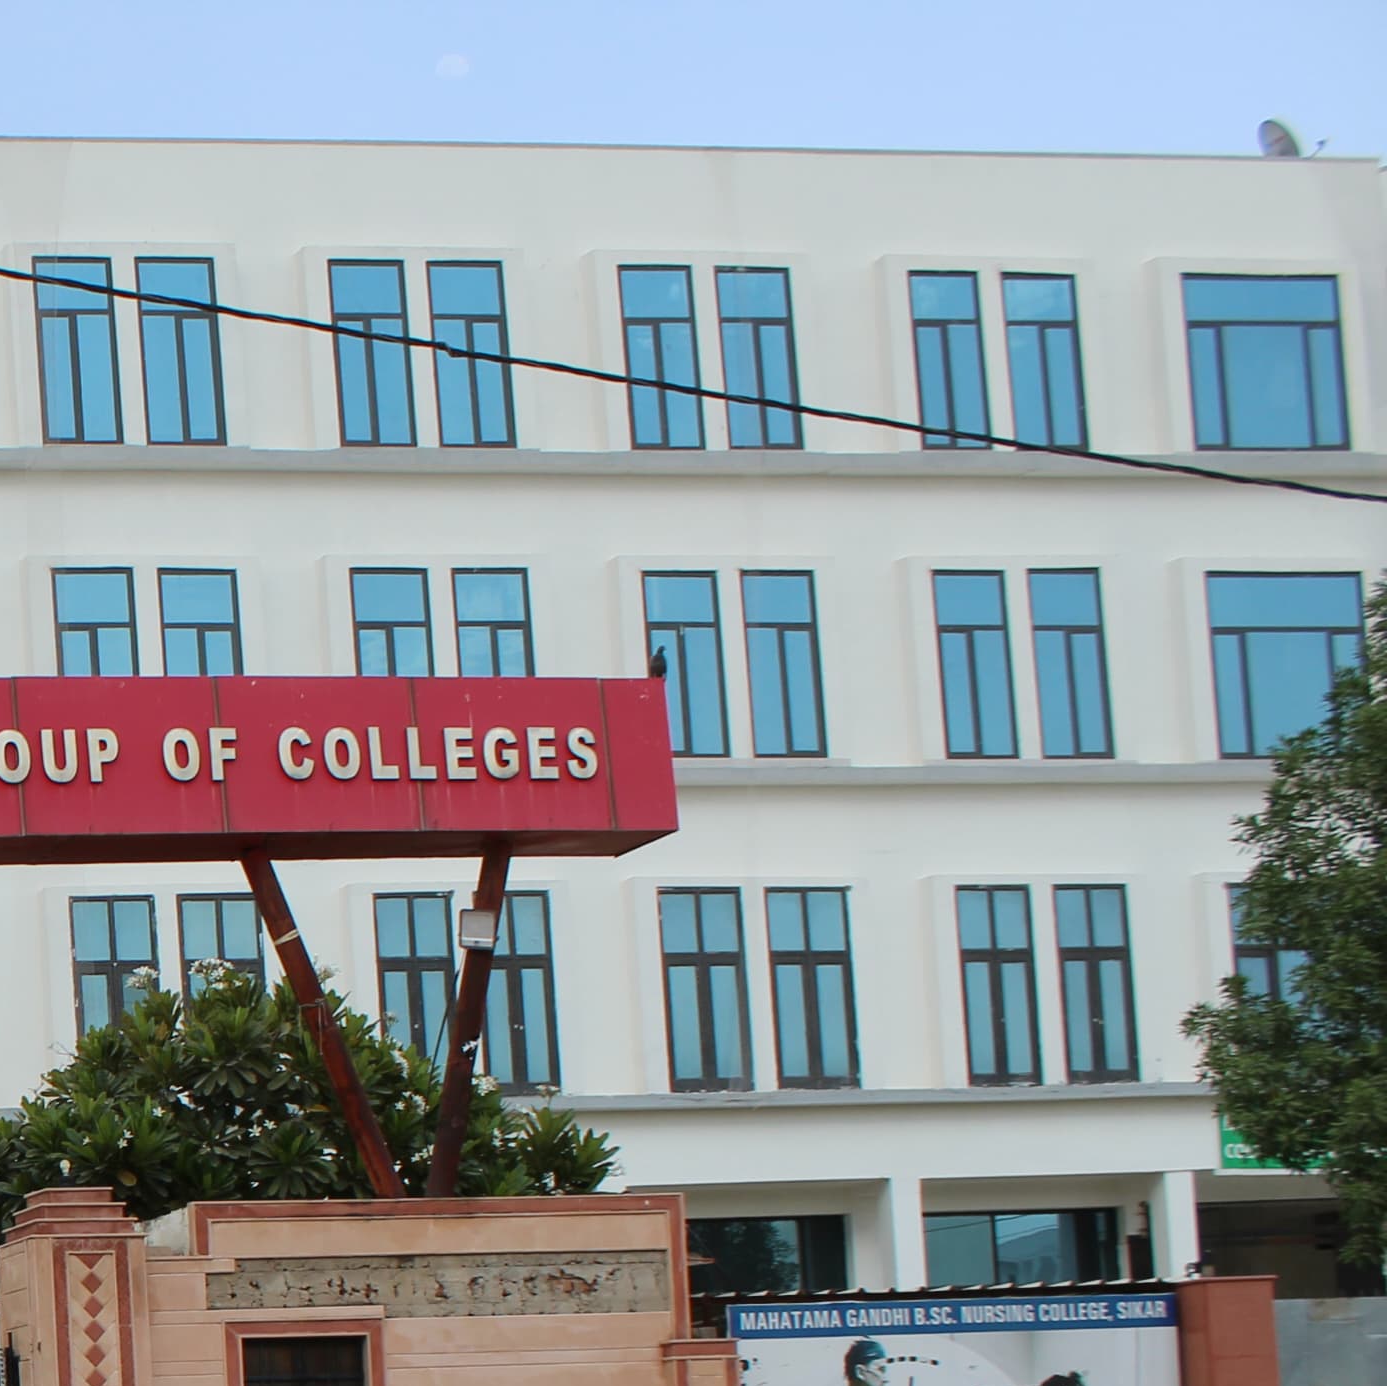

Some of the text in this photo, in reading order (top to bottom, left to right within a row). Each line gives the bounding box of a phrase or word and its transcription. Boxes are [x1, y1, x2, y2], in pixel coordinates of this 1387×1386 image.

[162, 726, 238, 782] OF
[279, 725, 599, 781] COLLEGES
[740, 1300, 1167, 1331] MAHATAMA GANDHI B.SC. NURSING COLLEGE, SIKAR
